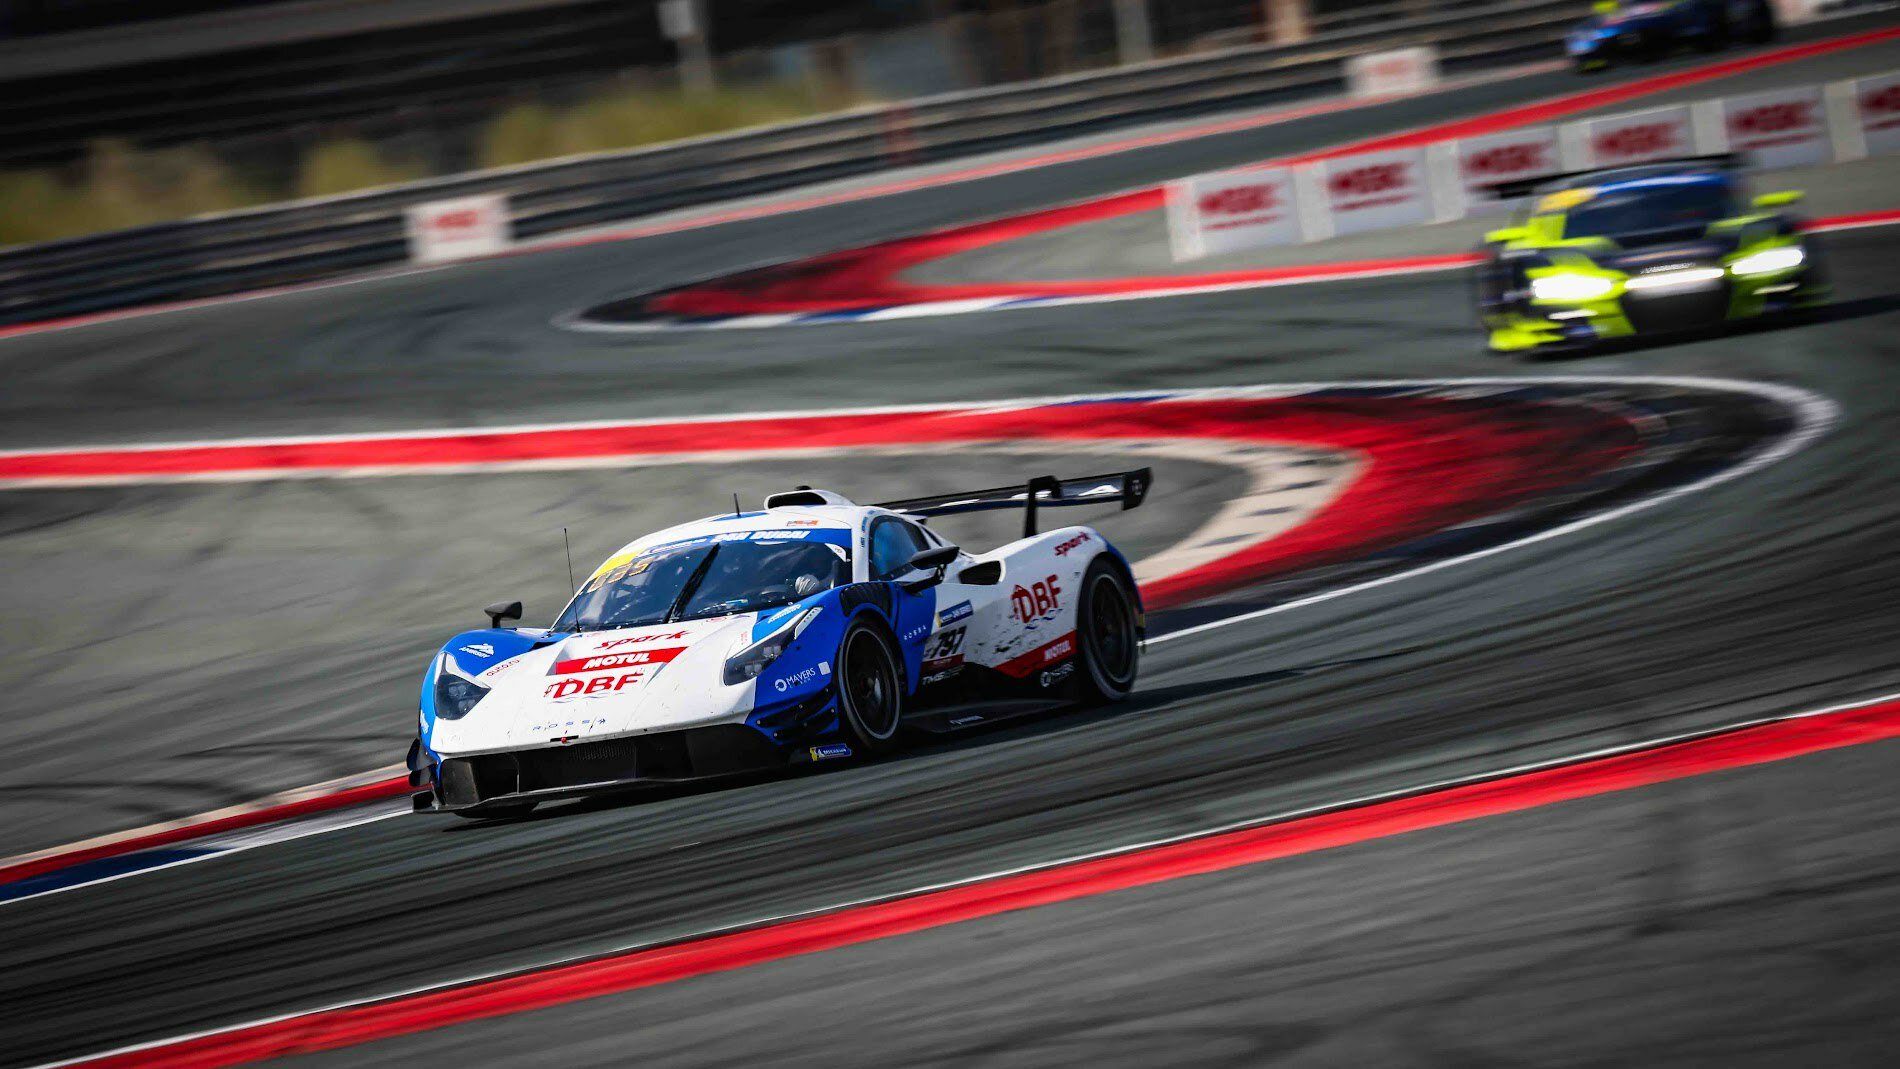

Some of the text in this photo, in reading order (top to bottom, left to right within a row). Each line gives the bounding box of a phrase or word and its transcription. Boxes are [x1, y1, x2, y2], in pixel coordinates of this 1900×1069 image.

[750, 530, 811, 540] DUBAI
[1054, 531, 1091, 557] spark
[1015, 573, 1062, 624] DBF
[593, 630, 692, 650] spark
[582, 653, 650, 670] MOTUL
[551, 673, 644, 699] DBF
[785, 667, 816, 686] MAVERS
